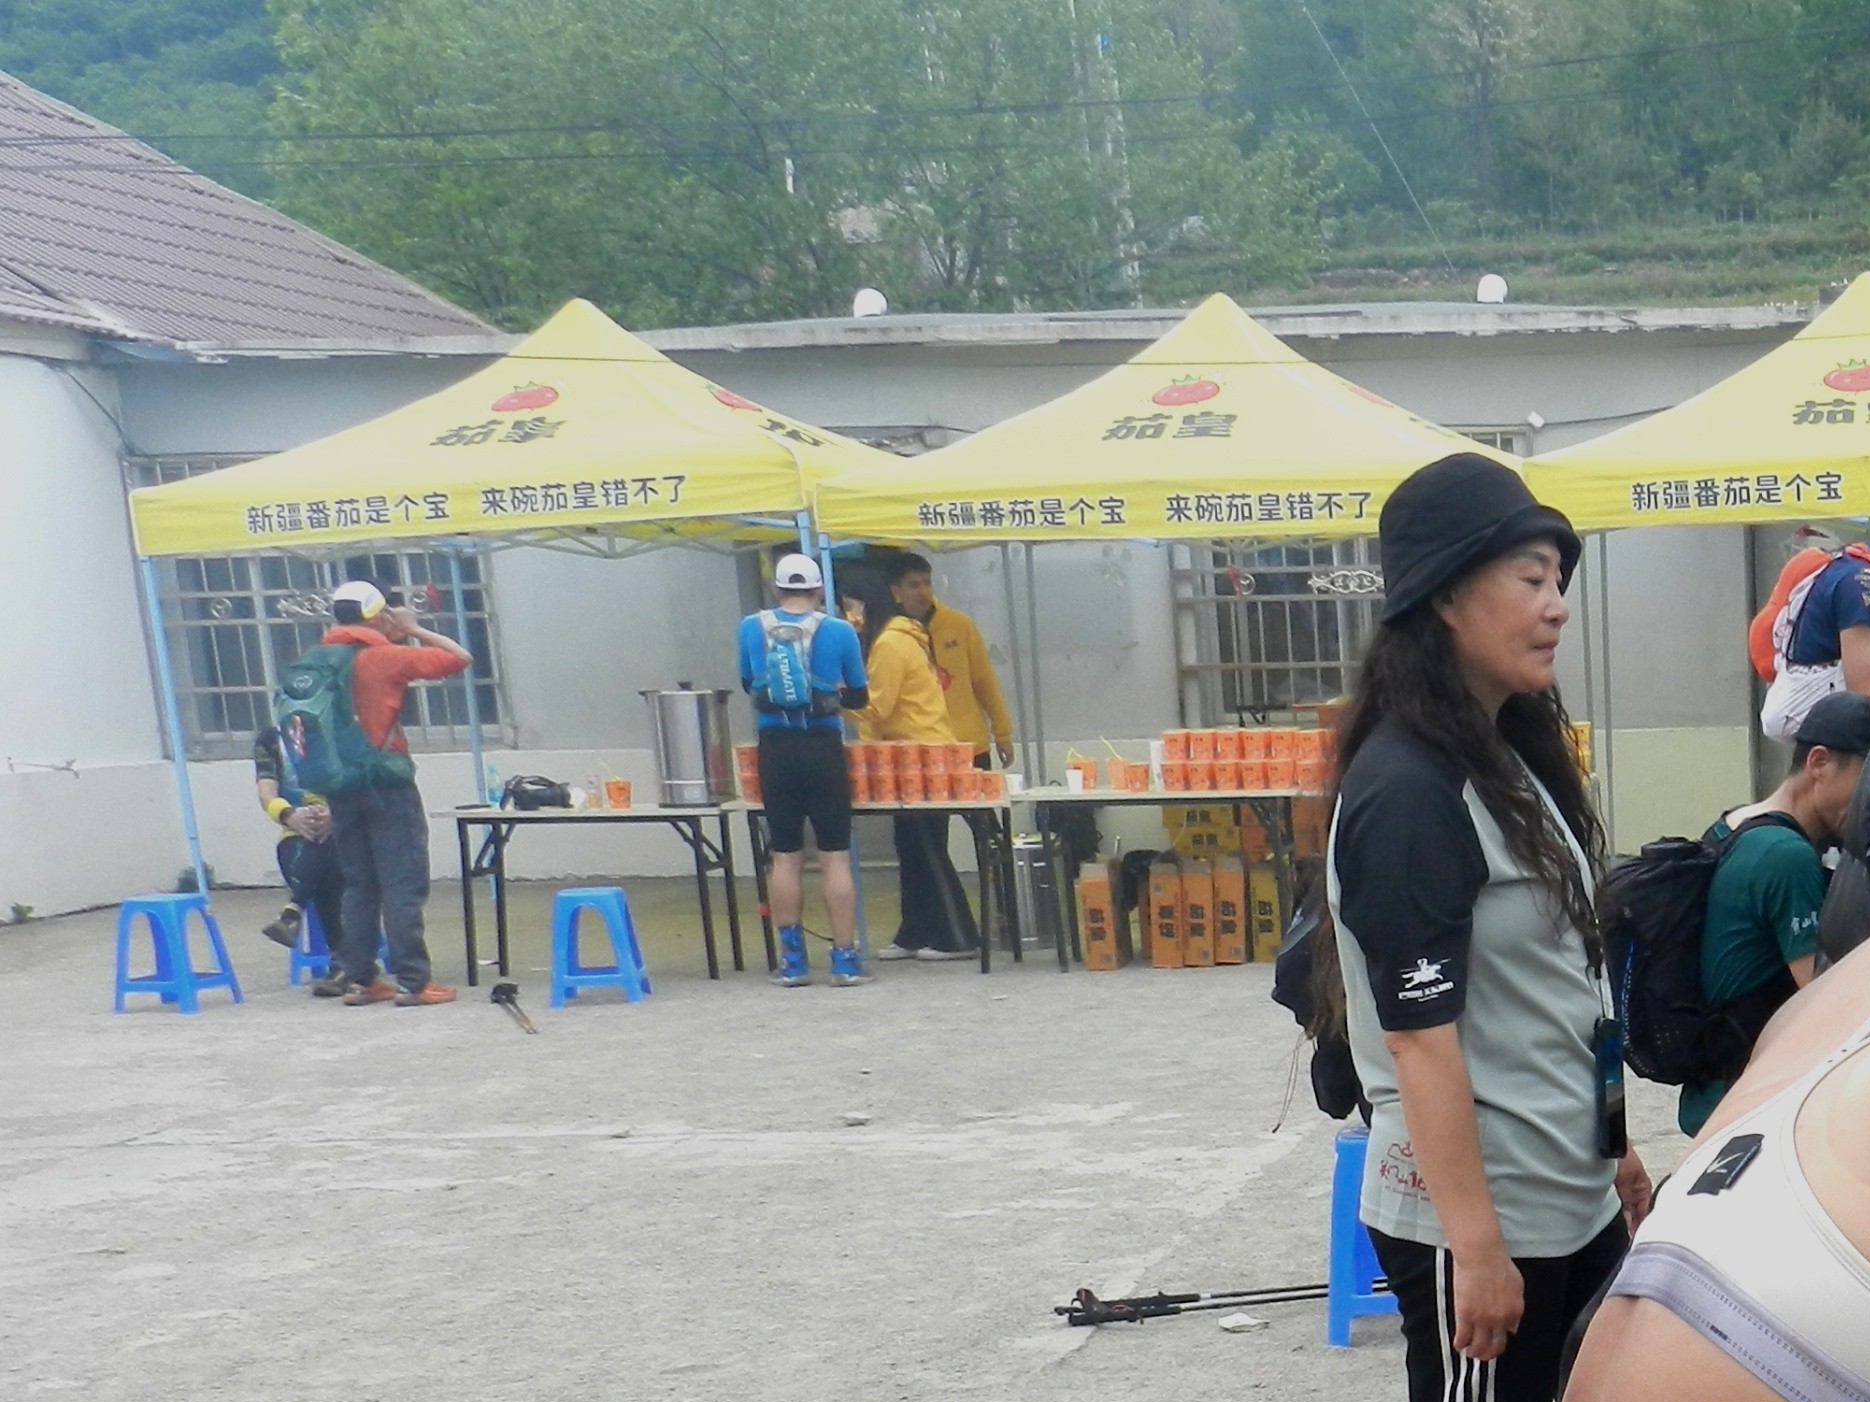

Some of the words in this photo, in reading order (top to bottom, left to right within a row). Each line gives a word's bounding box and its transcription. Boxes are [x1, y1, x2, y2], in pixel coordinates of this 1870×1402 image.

[1102, 411, 1238, 441] 茄皇
[246, 491, 451, 535] 新疆番茄是个宝
[481, 474, 687, 515] 来碗茄皇错不了
[917, 496, 1127, 528] 新疆番茄是个宝
[1165, 491, 1374, 524] 来碗茄皇错不了
[1630, 470, 1844, 512] 新疆番茄是个宝
